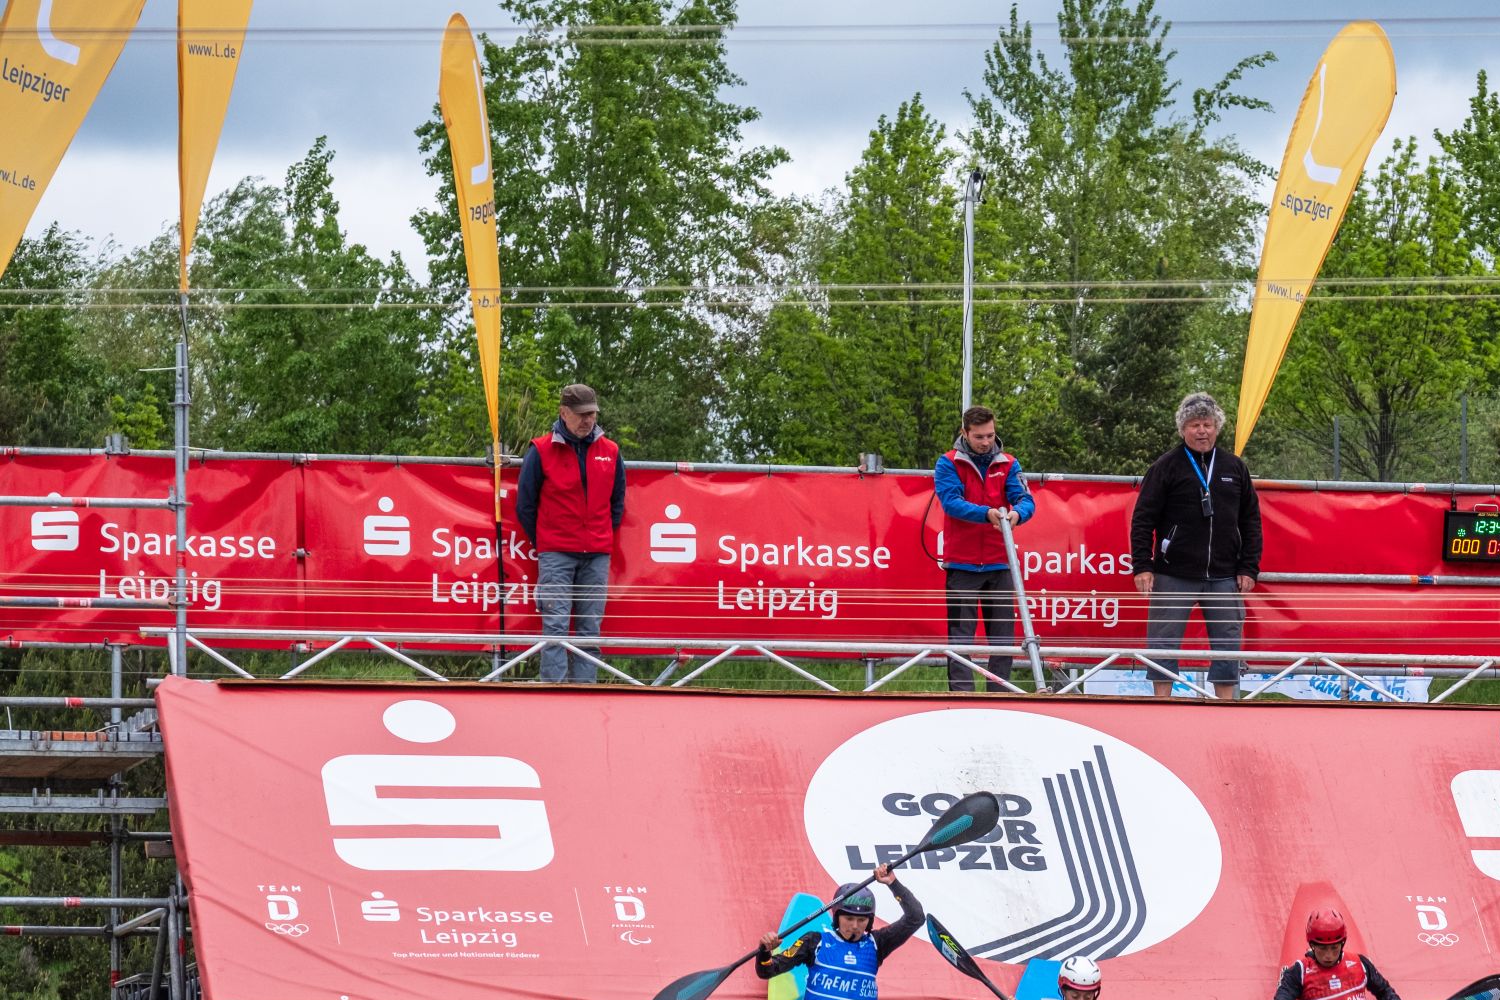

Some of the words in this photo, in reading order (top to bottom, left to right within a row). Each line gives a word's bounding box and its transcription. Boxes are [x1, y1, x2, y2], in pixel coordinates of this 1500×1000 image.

[187, 42, 236, 58] www.L.de
[2, 58, 70, 102] Leipziger
[100, 523, 276, 561] Sparkasse
[718, 535, 891, 572] Sparkasse
[1452, 538, 1480, 554] 000
[432, 573, 541, 612] Leipzi
[718, 580, 838, 619] Leipzig
[1014, 588, 1119, 628] eipzig
[846, 845, 1048, 871] LEIPZIG
[1406, 895, 1447, 903] TEAM
[416, 907, 553, 925] Sparkasse
[420, 928, 517, 947] Leipzig
